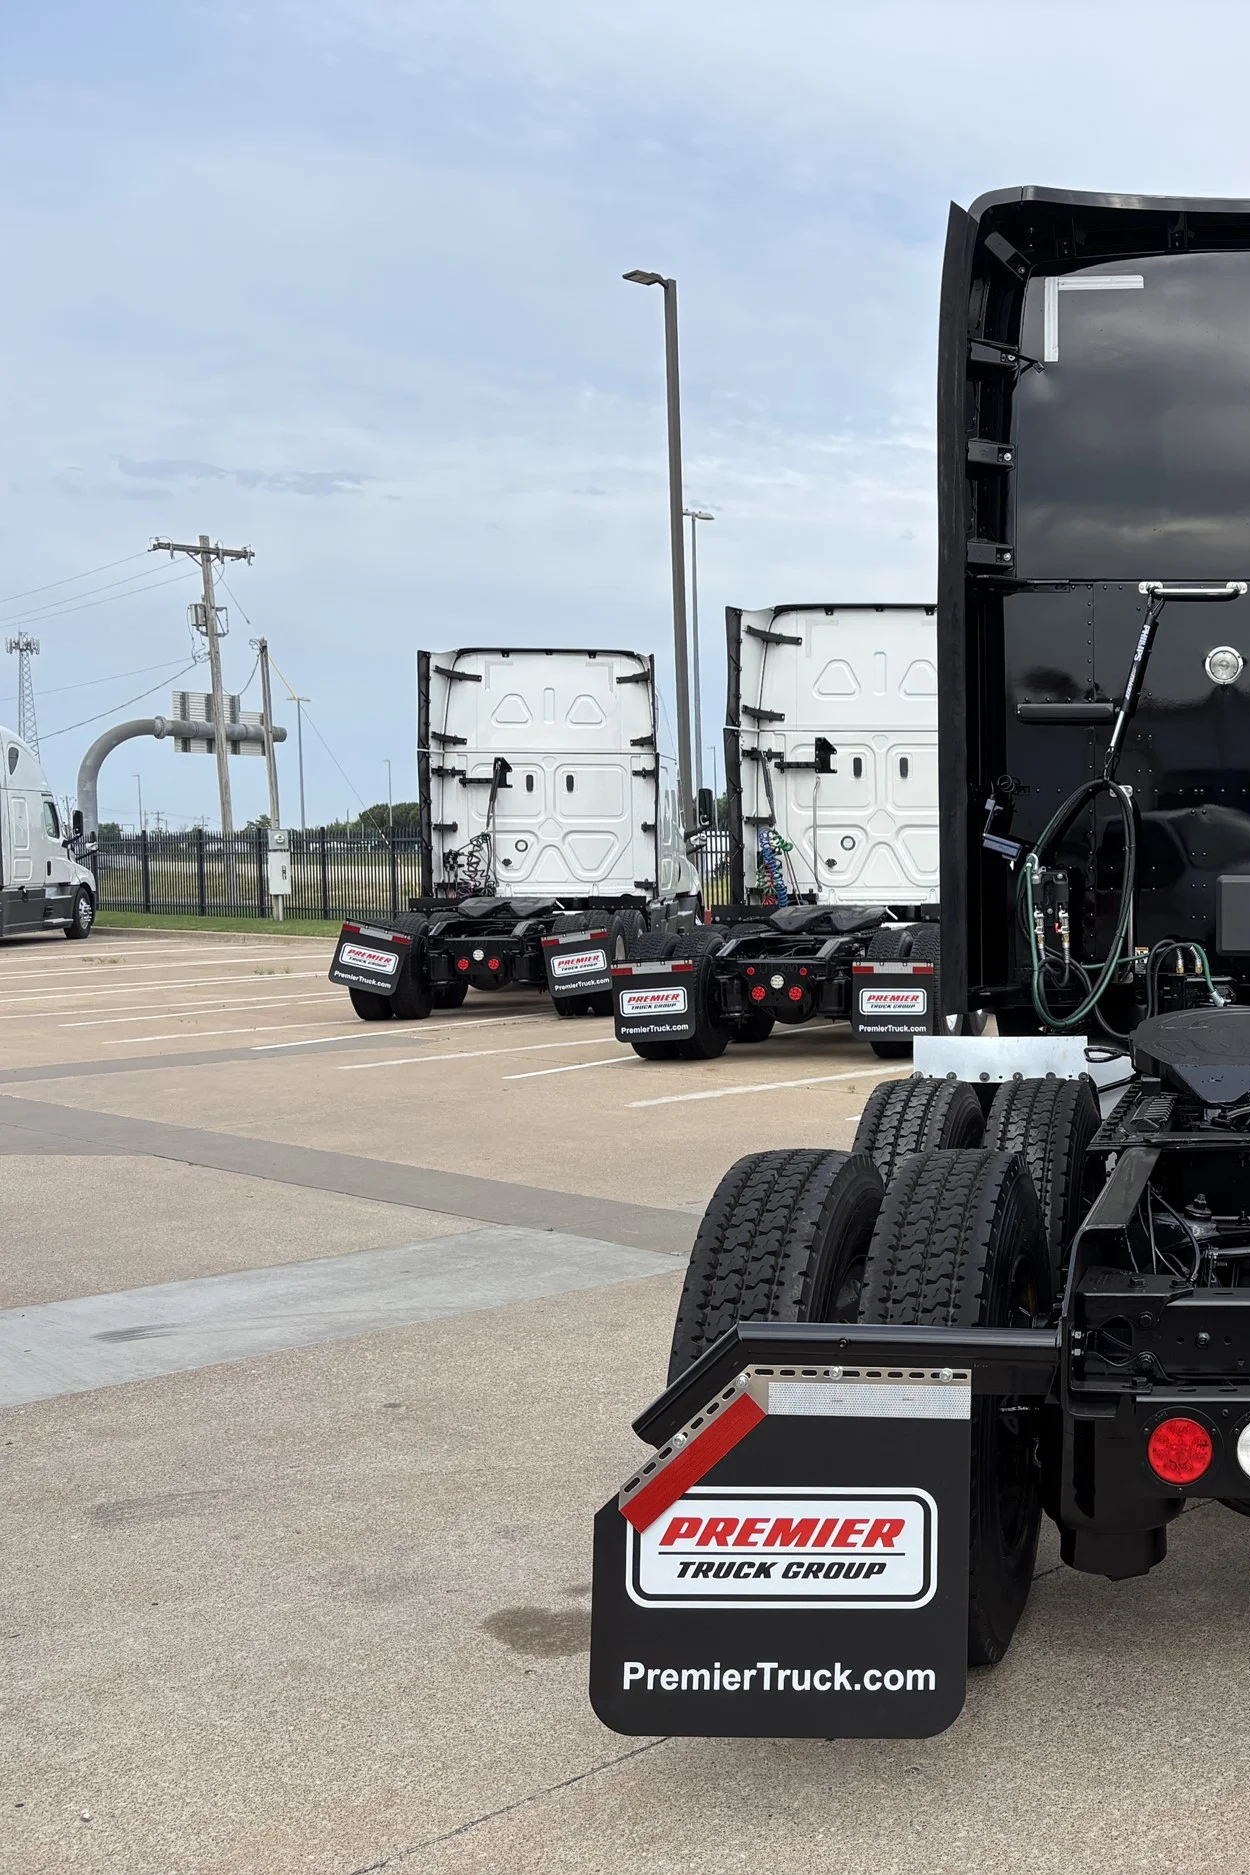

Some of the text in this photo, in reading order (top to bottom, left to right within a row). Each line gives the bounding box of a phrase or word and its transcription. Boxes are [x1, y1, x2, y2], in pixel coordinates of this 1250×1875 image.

[347, 949, 392, 963] PREMIER
[557, 955, 600, 967] PREMIER
[334, 970, 391, 989] PremierTruck.com
[554, 978, 610, 991] PremierTruck.com
[627, 993, 680, 1003] PREMIER
[620, 1024, 689, 1034] PremierTruck.com
[858, 1024, 927, 1032] PremierTruck.com
[658, 1516, 906, 1548] PREMIER
[676, 1561, 887, 1580] TRUCK GROUP
[622, 1661, 936, 1691] PremierTruck.com
